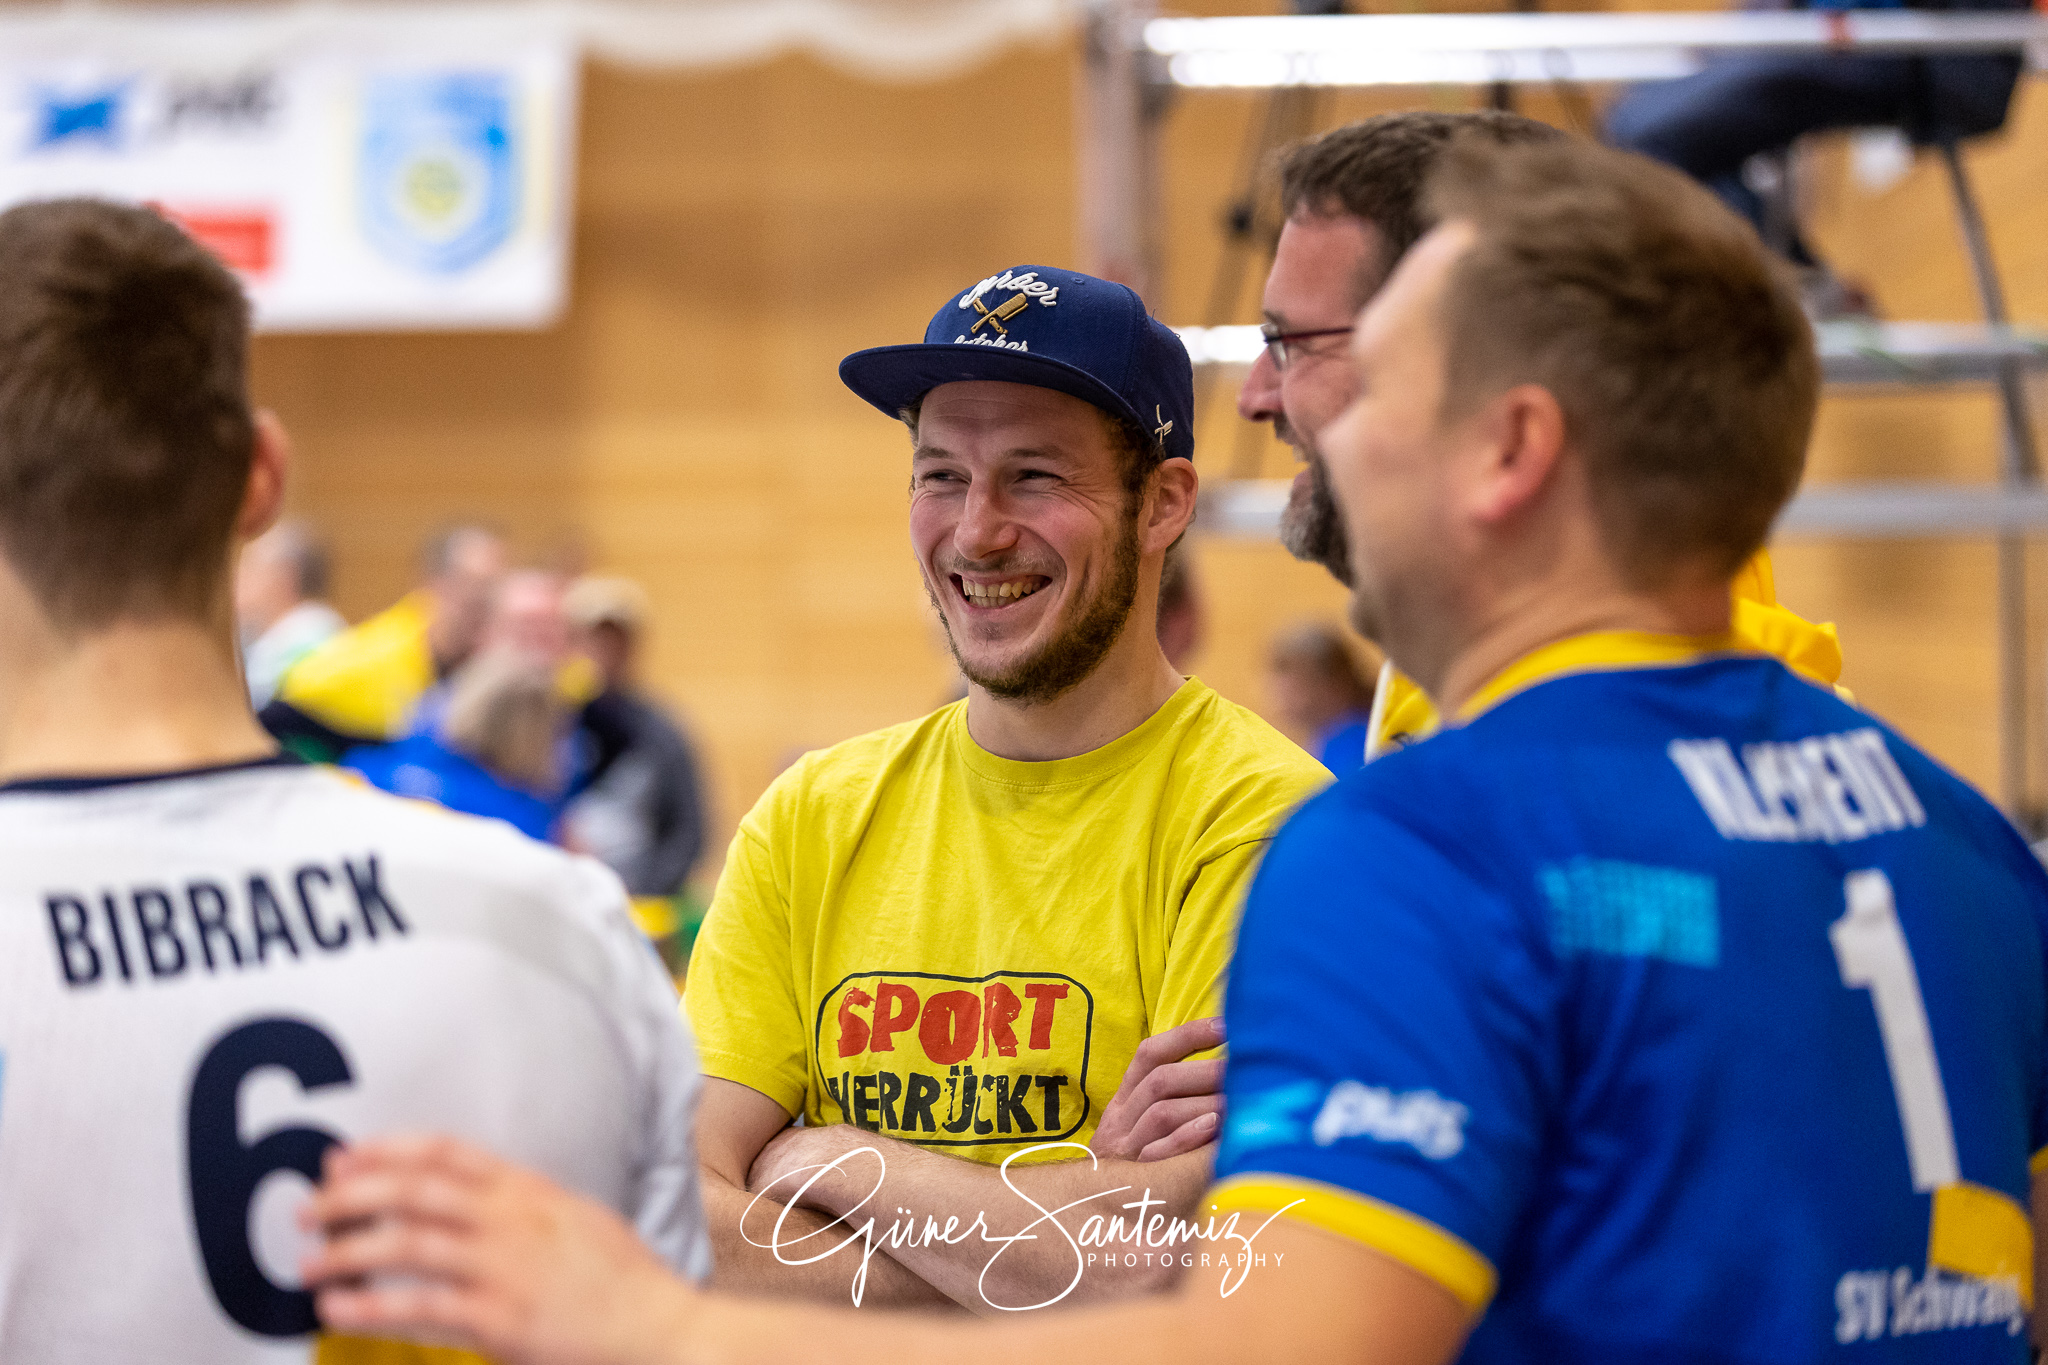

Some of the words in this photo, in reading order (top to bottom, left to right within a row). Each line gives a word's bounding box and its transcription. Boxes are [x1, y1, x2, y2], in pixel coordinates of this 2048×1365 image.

[44, 851, 413, 990] BIBRACK
[836, 978, 1070, 1066] SPORT
[1828, 867, 1963, 1193] 1
[827, 1065, 1069, 1135] VERRÜCKT
[181, 1010, 357, 1342] 6
